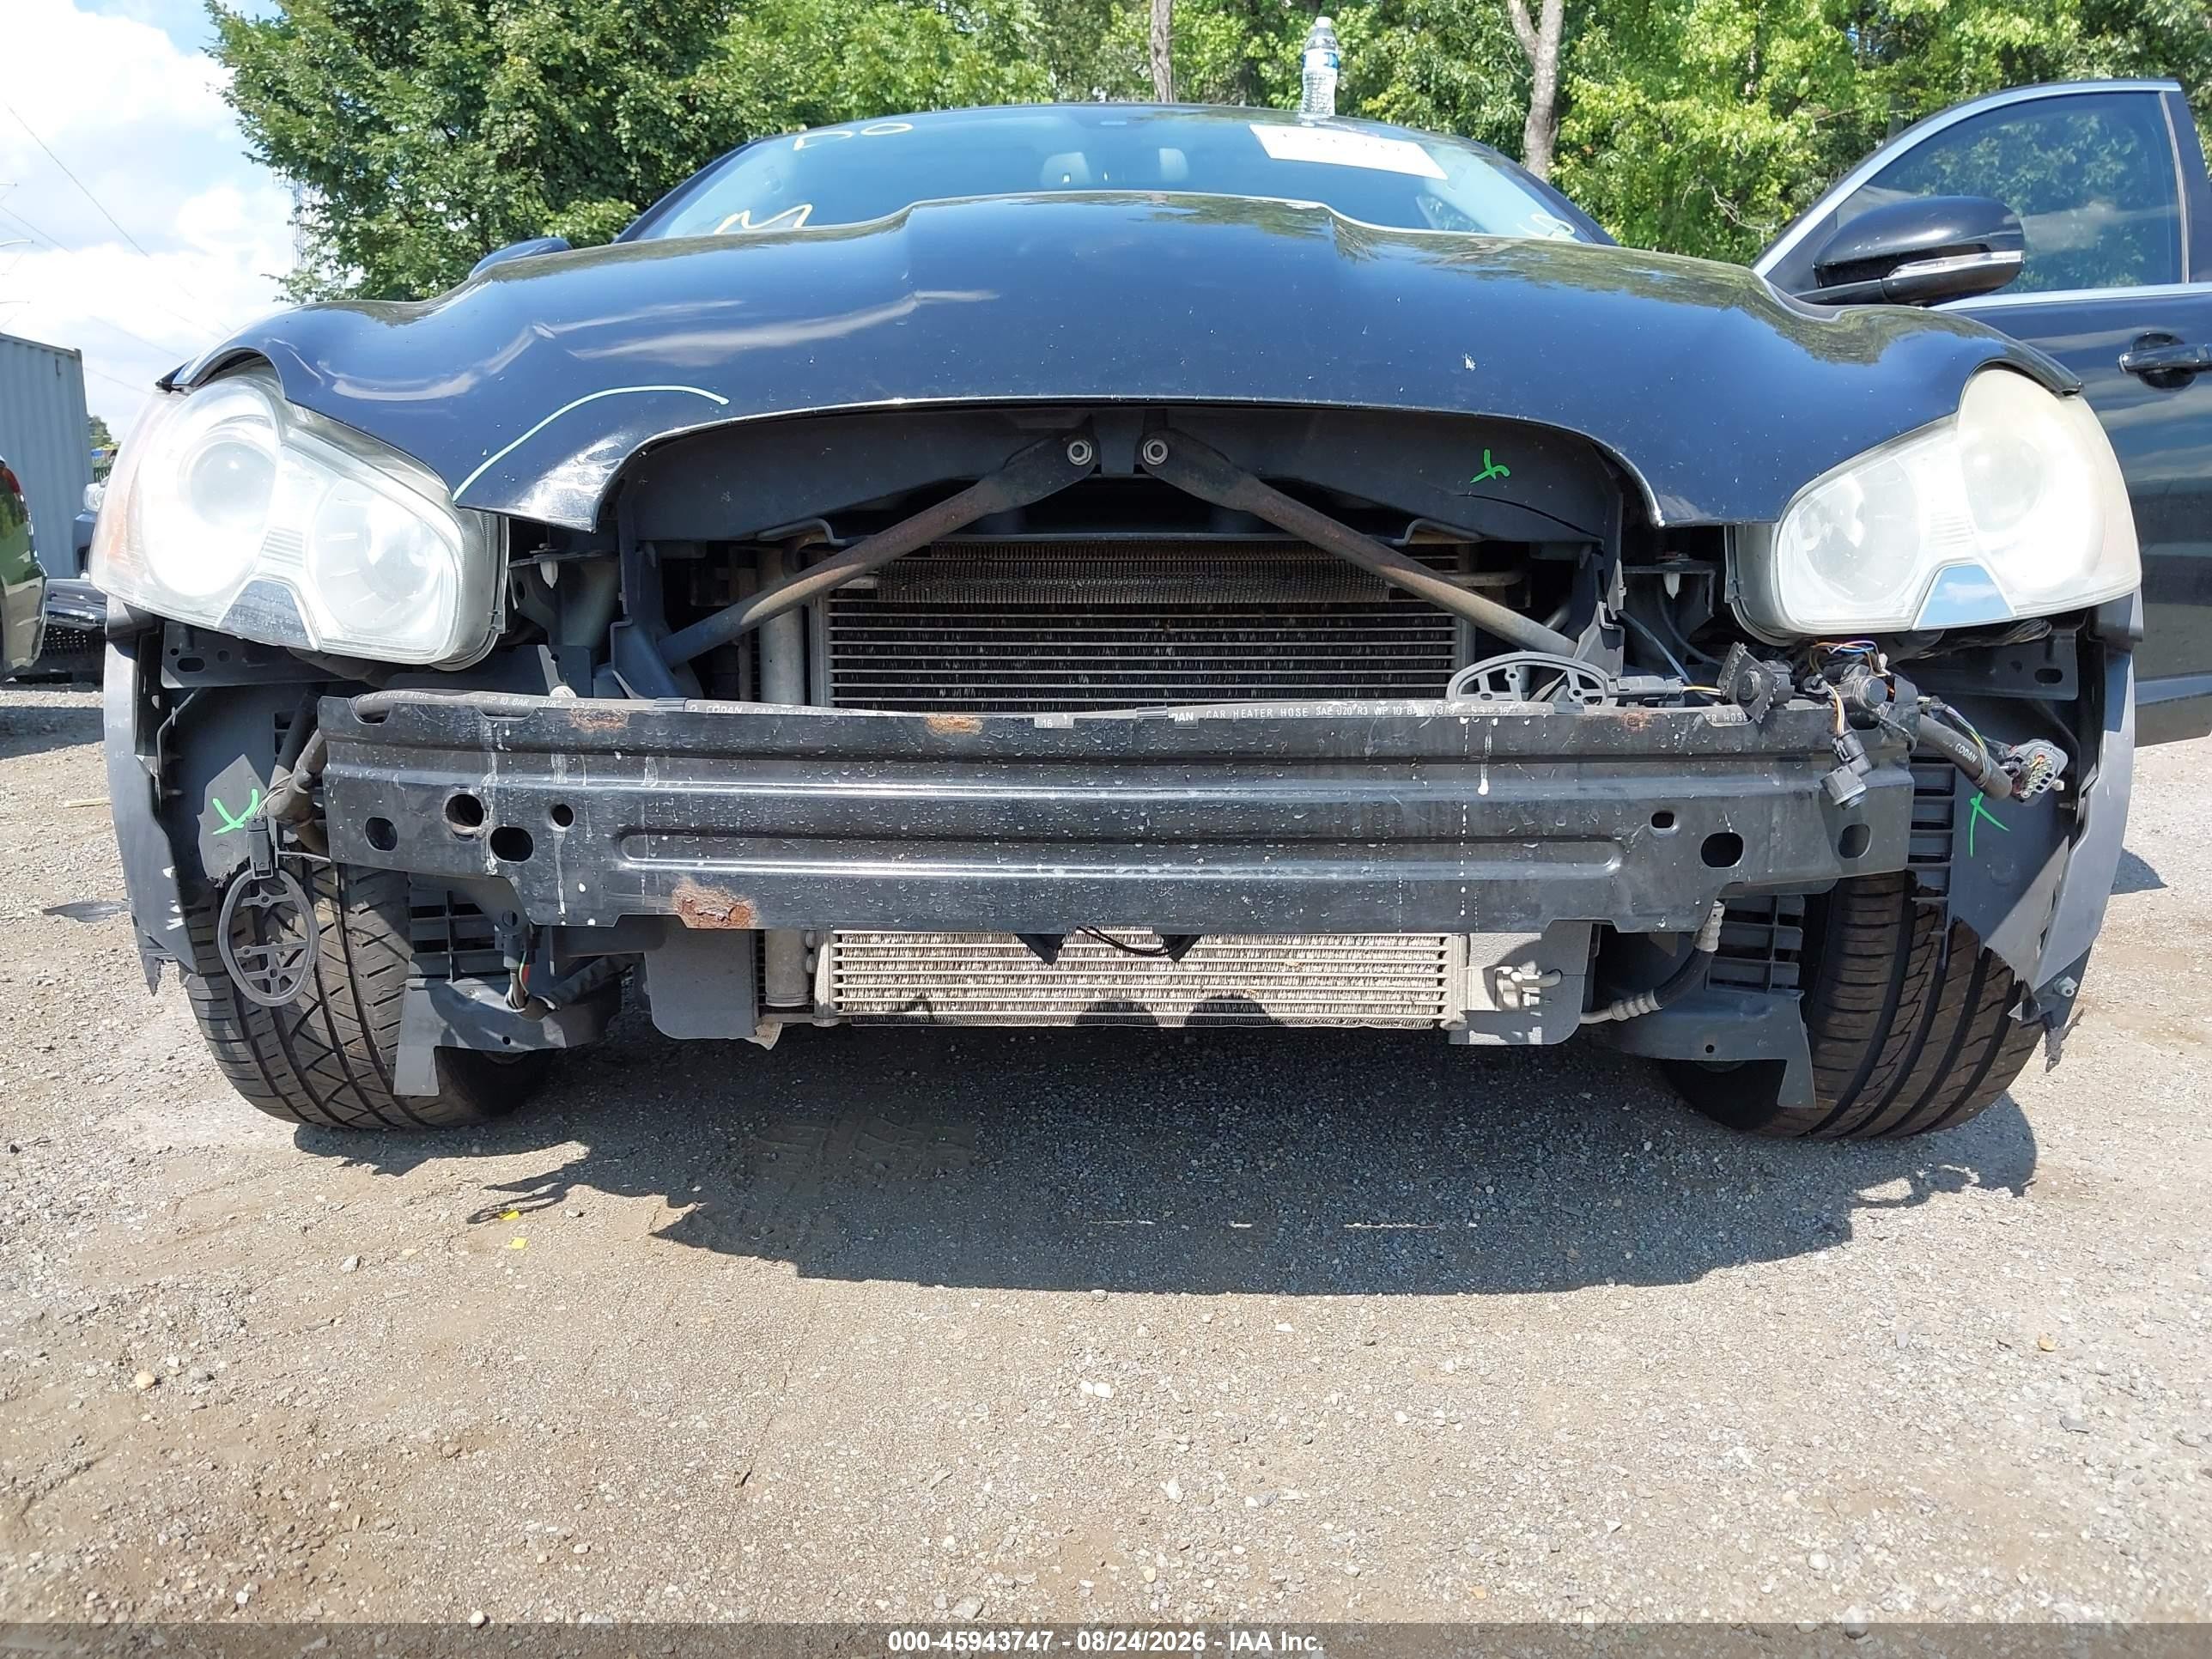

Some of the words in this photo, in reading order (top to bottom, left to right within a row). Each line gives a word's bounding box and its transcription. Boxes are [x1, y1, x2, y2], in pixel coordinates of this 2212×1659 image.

[1206, 710, 1226, 719] CAR
[1232, 708, 1273, 719] HEATER
[1280, 708, 1309, 717] HOSE
[1316, 706, 1334, 715] SAE
[1357, 706, 1368, 716] R3
[1374, 706, 1389, 716] WP
[1392, 706, 1402, 715] 10
[1954, 743, 1978, 763] CODAN
